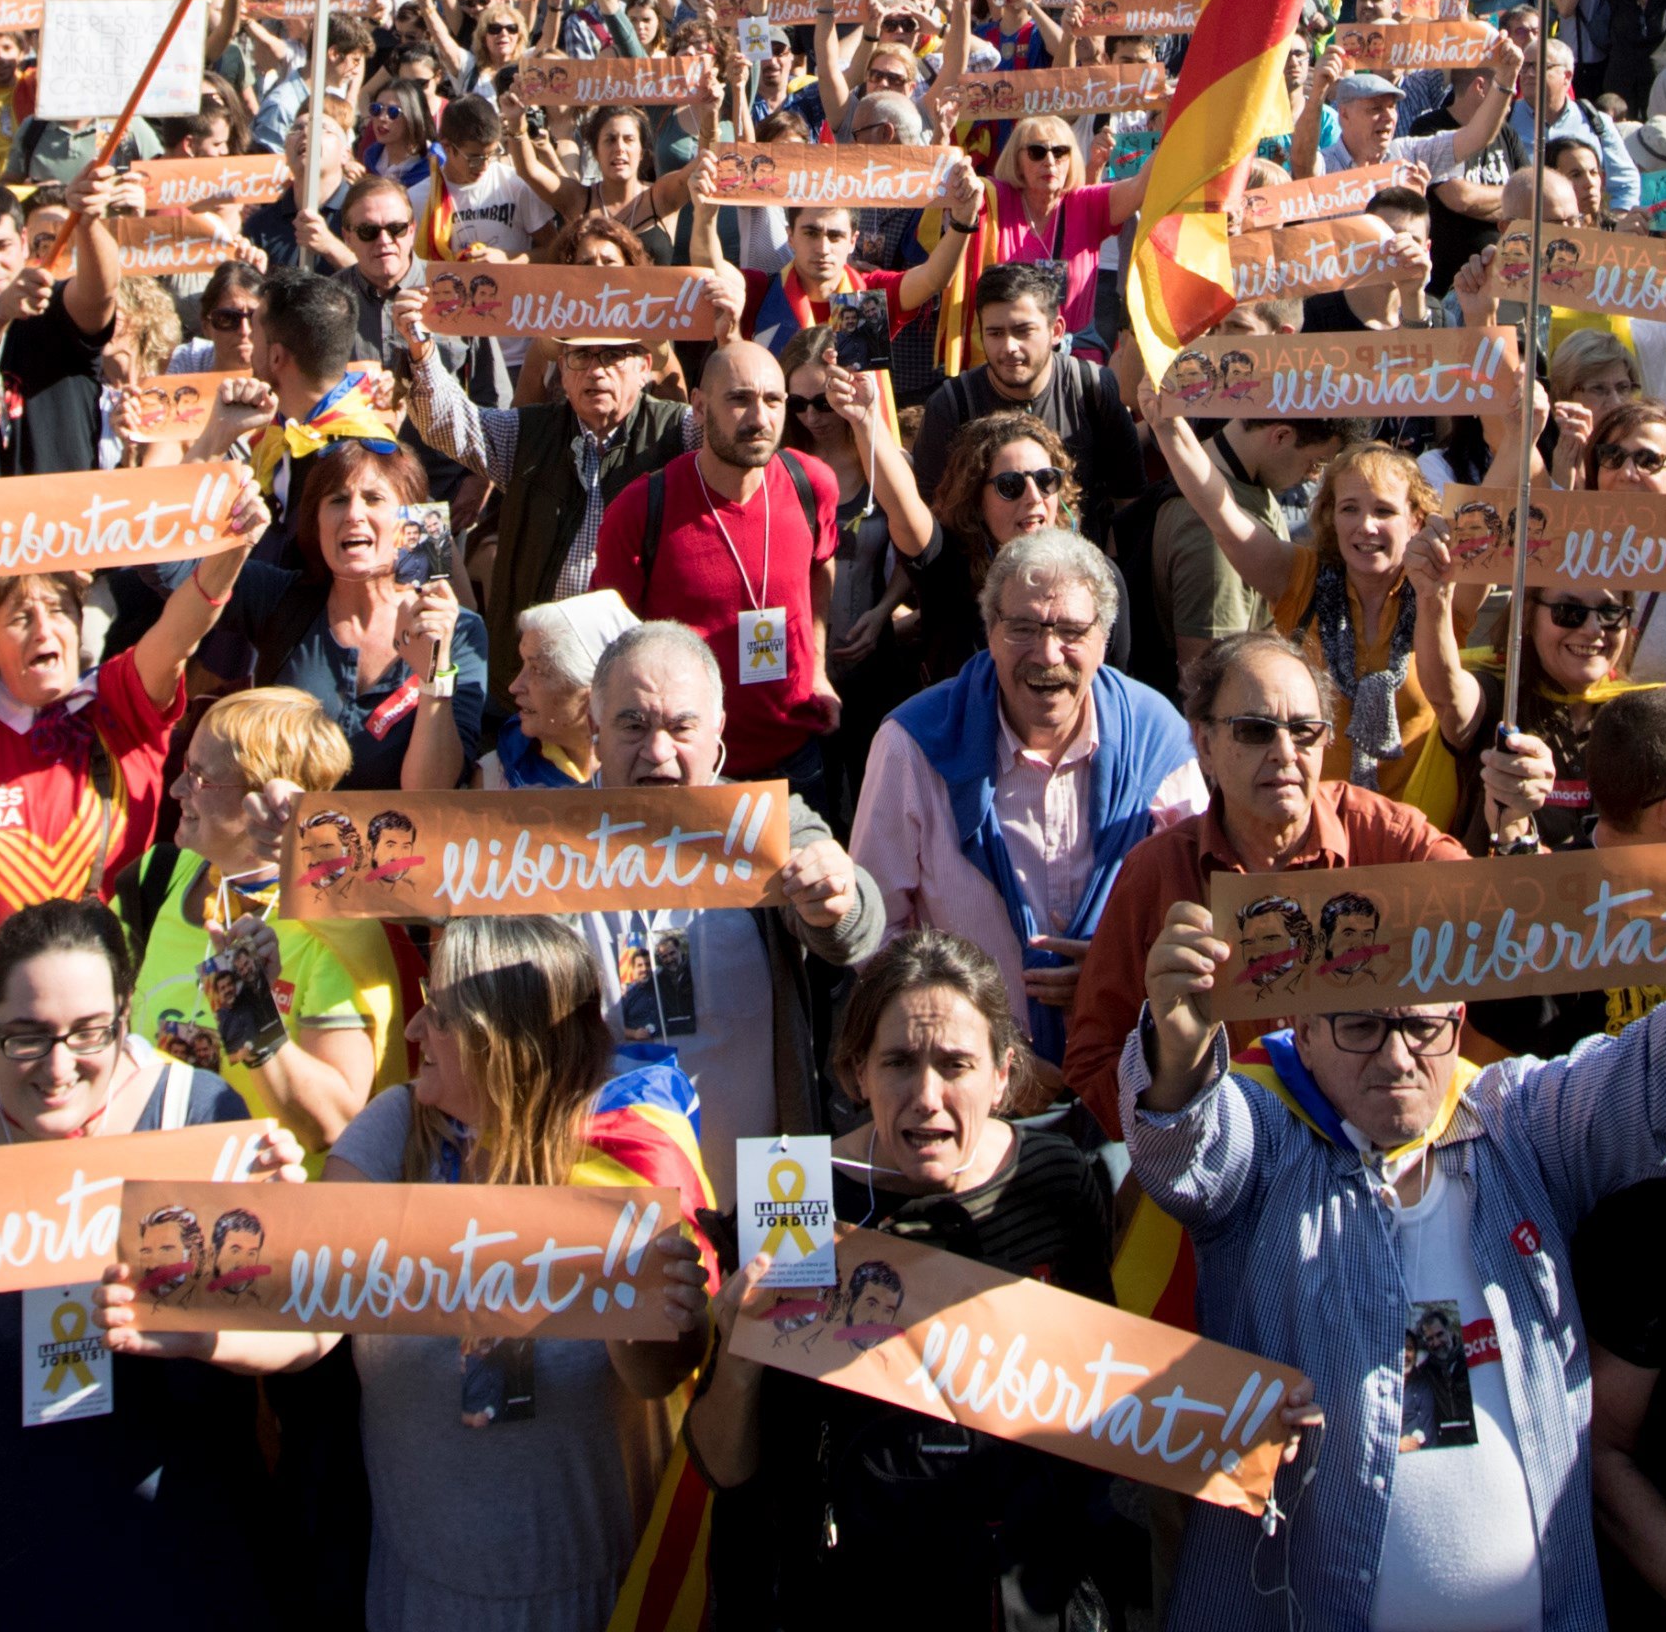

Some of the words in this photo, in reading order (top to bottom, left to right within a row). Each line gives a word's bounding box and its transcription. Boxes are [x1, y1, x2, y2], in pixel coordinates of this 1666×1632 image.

[1388, 27, 1499, 65] llibertat!!
[575, 63, 705, 102] llibertat!!
[1024, 68, 1158, 112] llibertat!!
[158, 155, 288, 204] llibertat!!
[786, 146, 953, 202] llibertat!!
[507, 275, 702, 331] llibertat!!
[1269, 337, 1502, 412] llibertat!!
[433, 793, 771, 902] llibertat!!
[755, 1201, 828, 1216] LLIBERTAT
[757, 1215, 826, 1228] JORDIS!
[282, 1202, 661, 1321] llibertat!!
[908, 1318, 1283, 1474] llibertat!!
